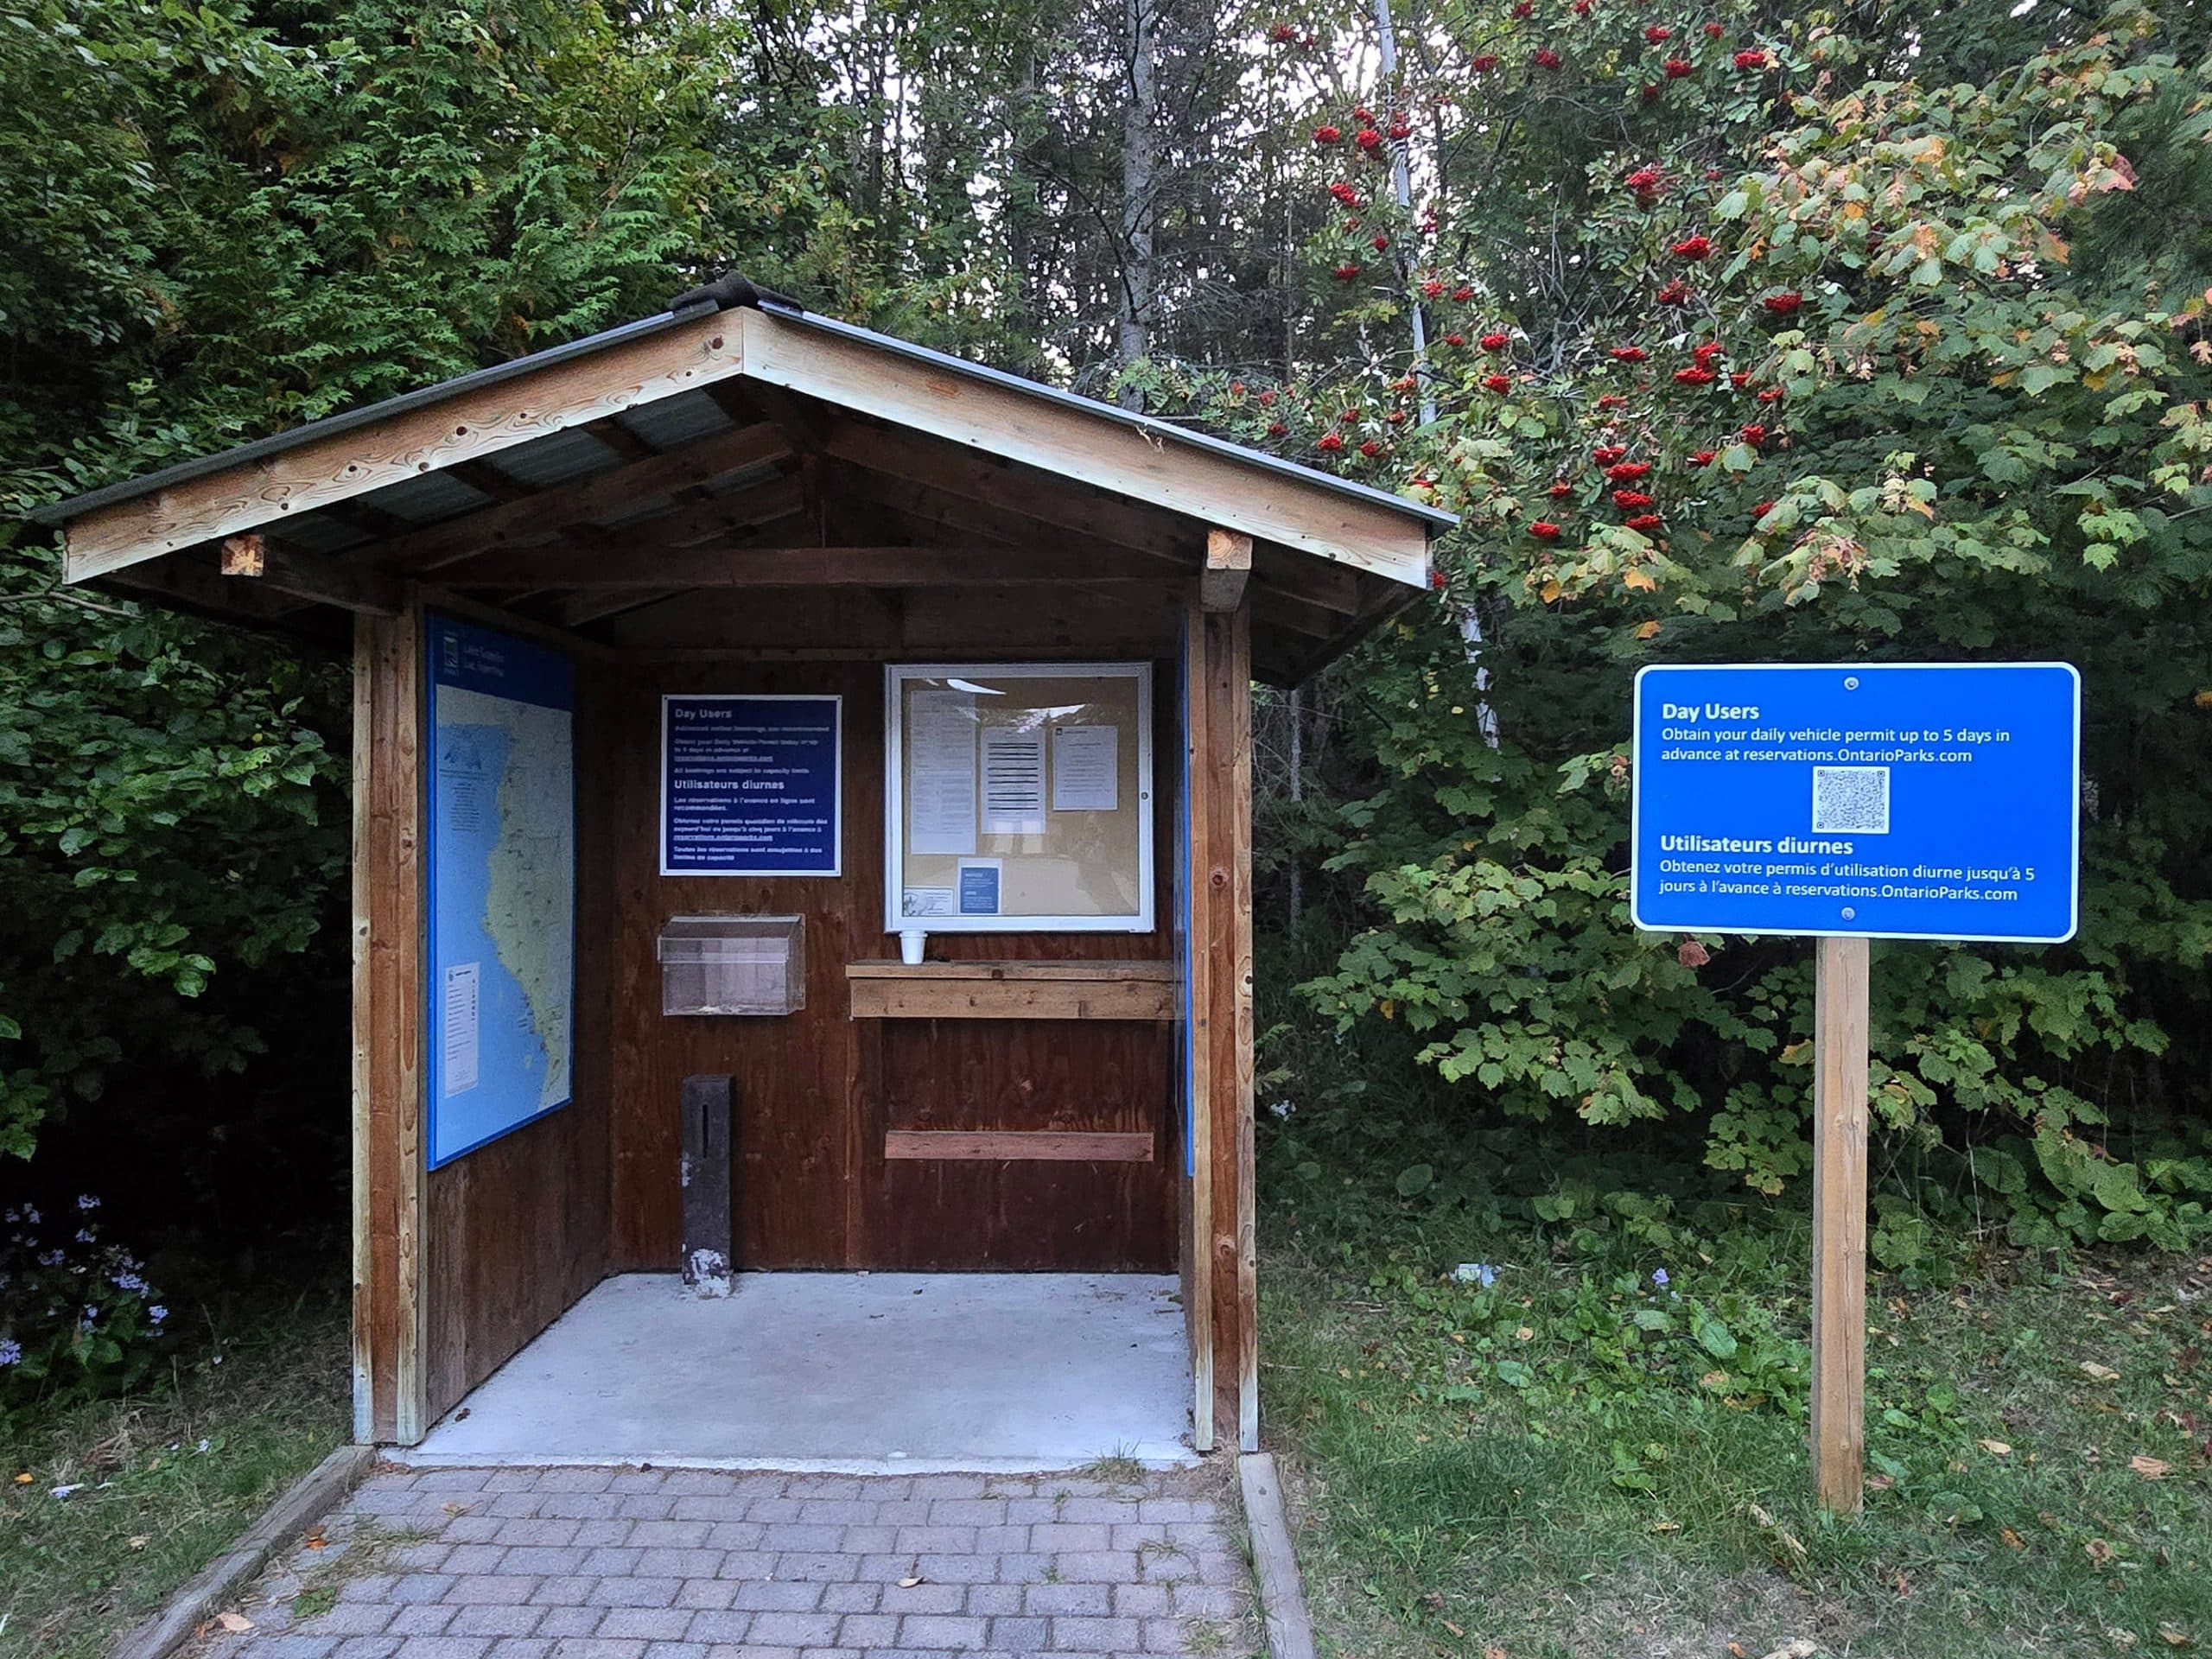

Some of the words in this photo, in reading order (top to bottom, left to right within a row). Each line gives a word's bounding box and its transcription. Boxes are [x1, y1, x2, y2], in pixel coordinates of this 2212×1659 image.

[676, 709, 696, 721] Day
[700, 709, 732, 719] Users
[1662, 703, 1700, 722] Day
[1706, 703, 1759, 719] Users
[1662, 728, 1710, 741] Obtain
[1714, 731, 1746, 742] your
[1751, 728, 1785, 743] daily
[1789, 728, 1840, 741] vehicle
[1846, 729, 1895, 743] permit
[1900, 732, 1918, 743] up
[1923, 730, 1938, 741] to
[1943, 729, 1952, 741] 5
[1957, 728, 1991, 744] days
[1997, 730, 2009, 741] in
[1662, 747, 1721, 760] advance
[1726, 749, 1739, 760] at
[1744, 749, 1972, 761] reservations.OntarioParks.com
[675, 780, 739, 790] Utilisateurs
[742, 780, 785, 790] diurnes
[1662, 836, 1772, 853] Utilisateurs
[1777, 836, 1853, 854] diurnes
[1660, 860, 1719, 873] Obtenez
[1724, 863, 1762, 874] votre
[1766, 863, 1816, 877] permis
[1821, 863, 1908, 877] d'utilisation
[1913, 865, 1962, 879] diurne
[1967, 868, 2020, 882] jusqu'à
[2026, 868, 2034, 880] 5
[1659, 880, 1695, 894] jours
[1700, 880, 1707, 892] à
[1713, 880, 1769, 894] l'avance
[1773, 882, 1781, 894] à
[1785, 883, 2018, 900] reservations.OntarioParks.com
